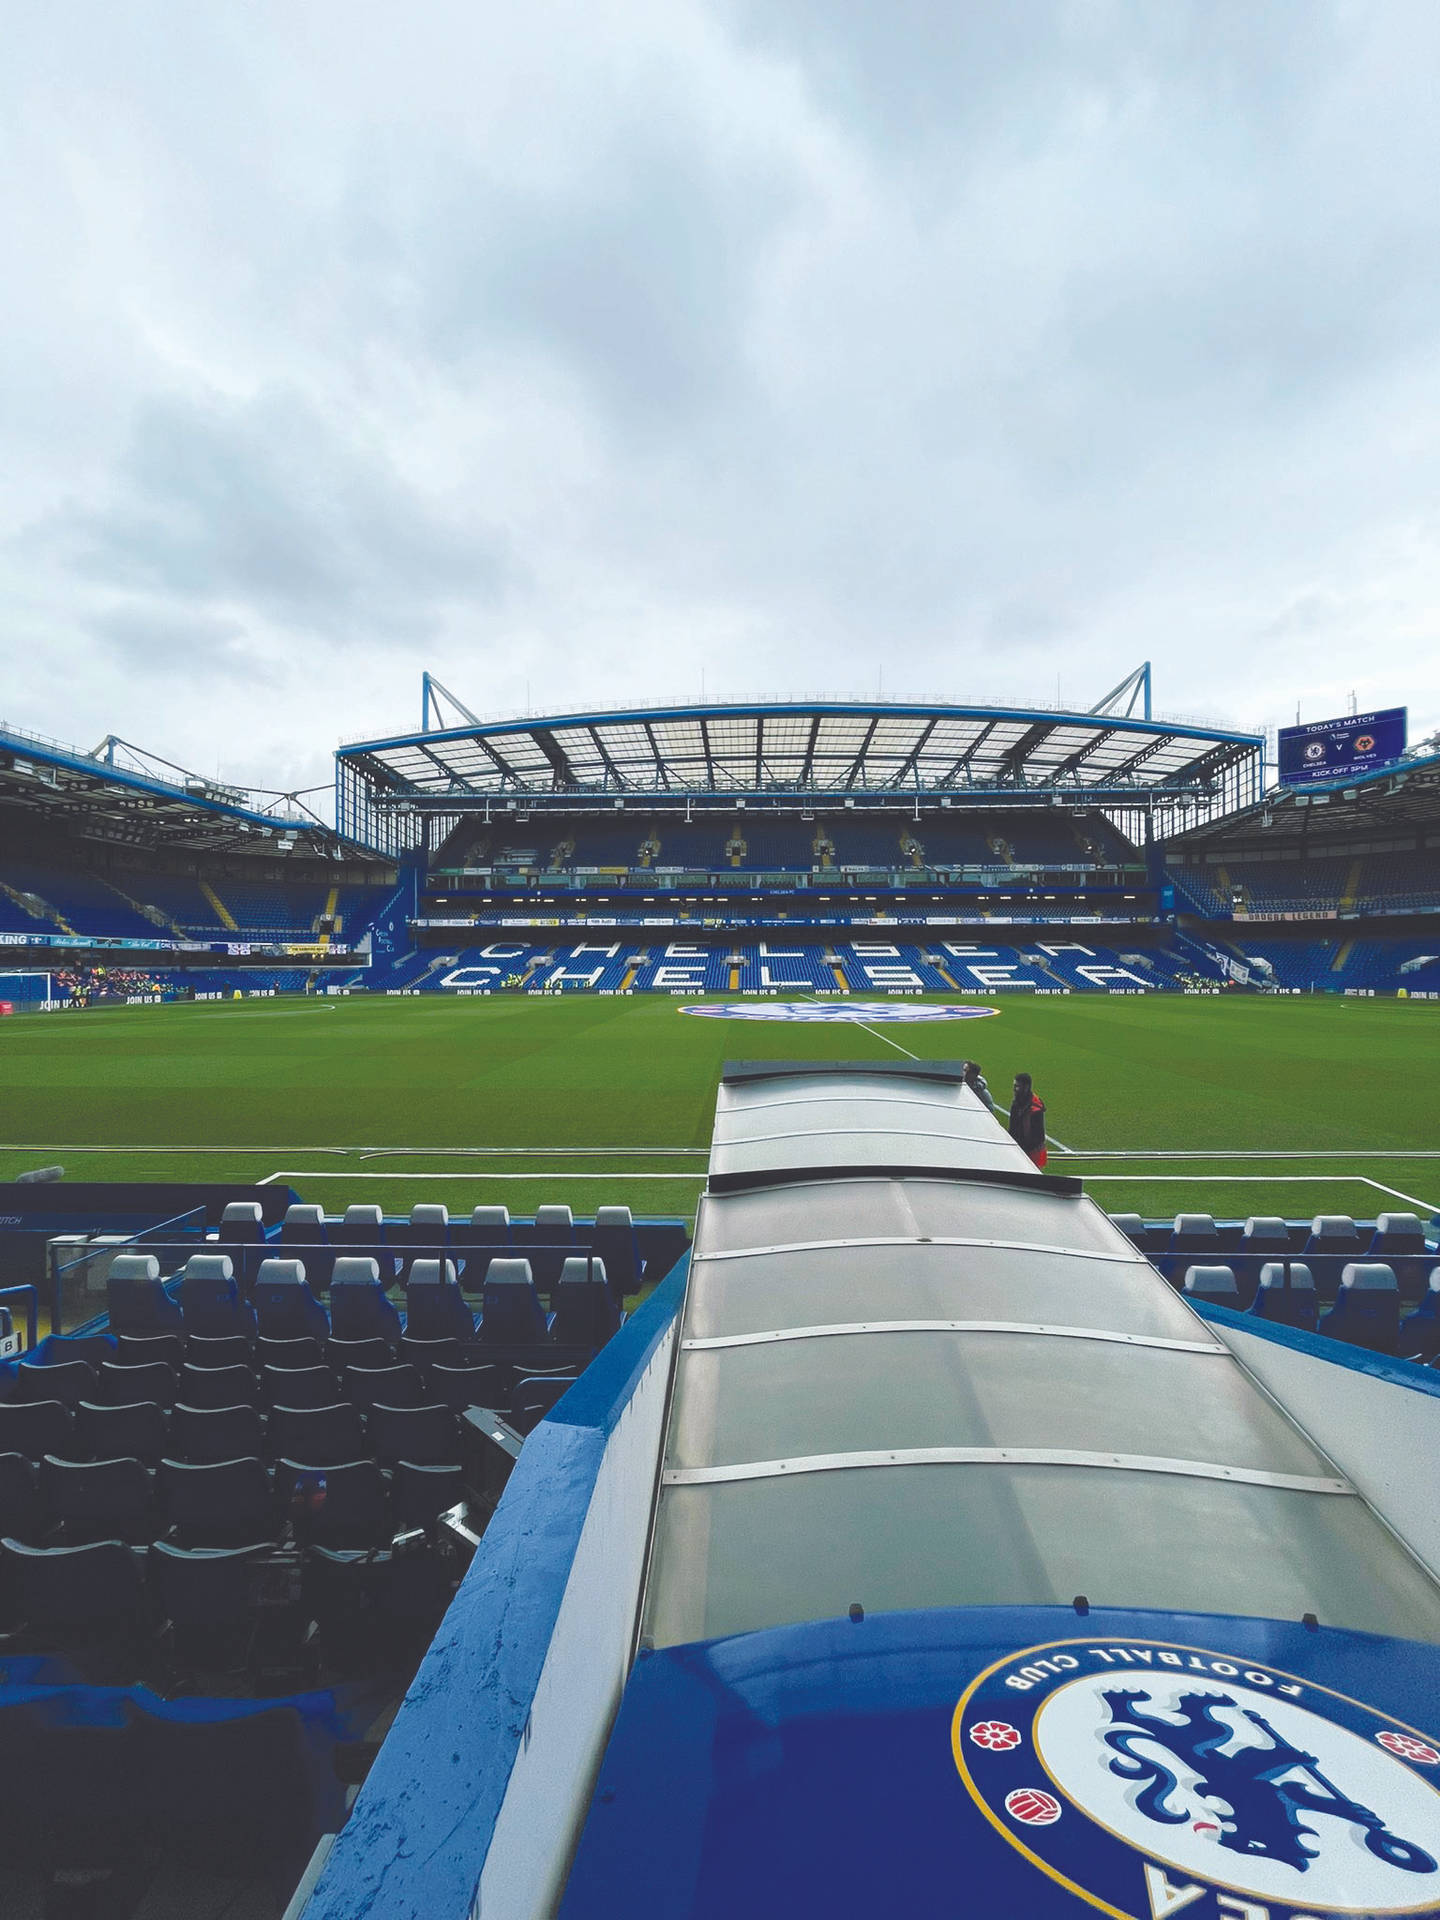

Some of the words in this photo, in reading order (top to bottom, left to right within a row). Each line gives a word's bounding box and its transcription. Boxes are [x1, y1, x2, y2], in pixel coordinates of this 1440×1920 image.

[1306, 722, 1341, 733] TODAY'S
[1343, 715, 1375, 727] MATCH
[1312, 769, 1330, 777] KICK
[1332, 767, 1349, 775] OFF
[480, 942, 1096, 958] CHELSEA
[440, 966, 1155, 987] CHELSEA
[40, 1000, 60, 1010] JOIN
[126, 995, 142, 1005] JOIN
[144, 995, 153, 1003] US
[1004, 1654, 1080, 1691] CLUB
[1088, 1648, 1303, 1697] FOOTBALL
